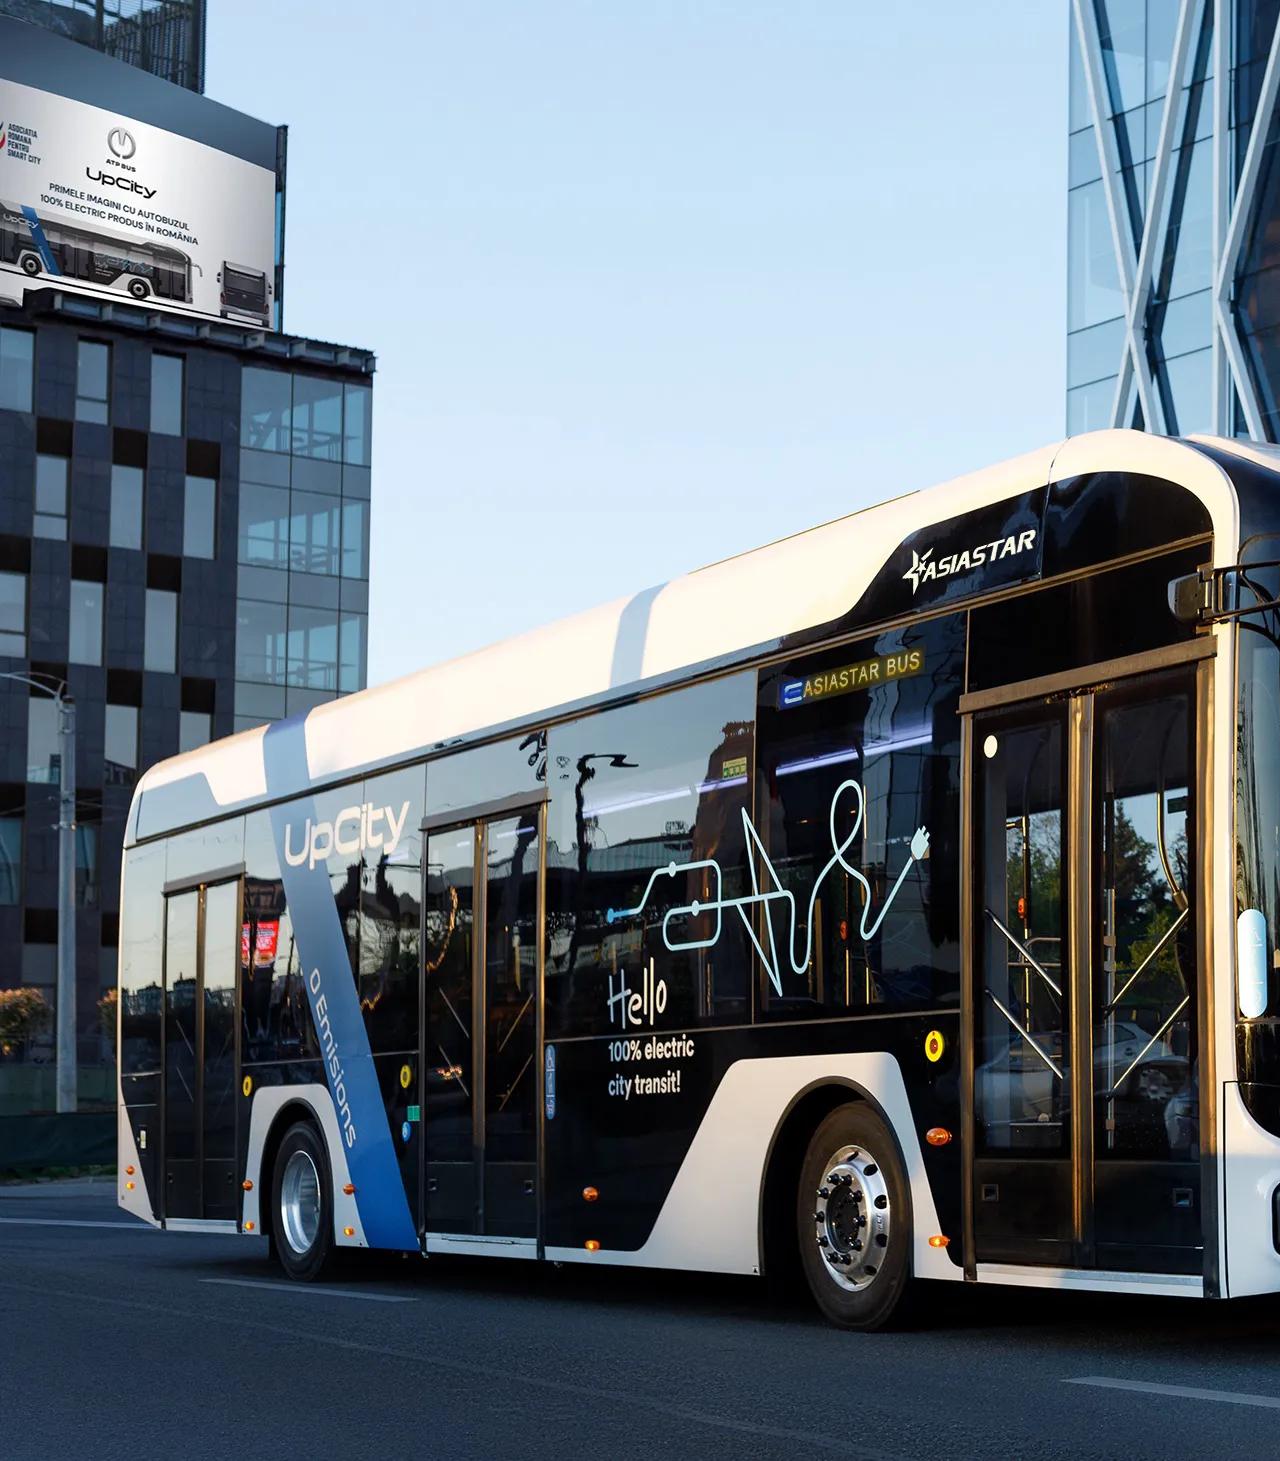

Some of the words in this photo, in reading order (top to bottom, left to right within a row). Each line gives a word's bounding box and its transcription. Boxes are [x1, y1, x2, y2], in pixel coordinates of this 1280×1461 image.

[8, 148, 27, 161] SMART
[28, 154, 41, 165] CITY
[106, 158, 120, 167] ATP
[121, 163, 136, 173] BUS
[86, 166, 157, 199] UpCity
[40, 194, 64, 208] 100%
[65, 200, 106, 219] ELECTRIC
[108, 212, 144, 229] PRODUS
[49, 183, 85, 200] PRIMELE
[86, 193, 122, 210] IMAGINI
[123, 204, 136, 215] CU
[137, 209, 190, 231] AUTOBUZUL
[921, 529, 1037, 583] ASIASTAR
[803, 662, 880, 698] ASIASTAR
[886, 651, 921, 677] BUS
[284, 800, 411, 871] UpCity
[607, 956, 667, 1030] Hello
[608, 1039, 641, 1062] 100%
[644, 1033, 695, 1060] electric
[608, 1073, 632, 1101] city
[634, 1070, 681, 1095] transit!
